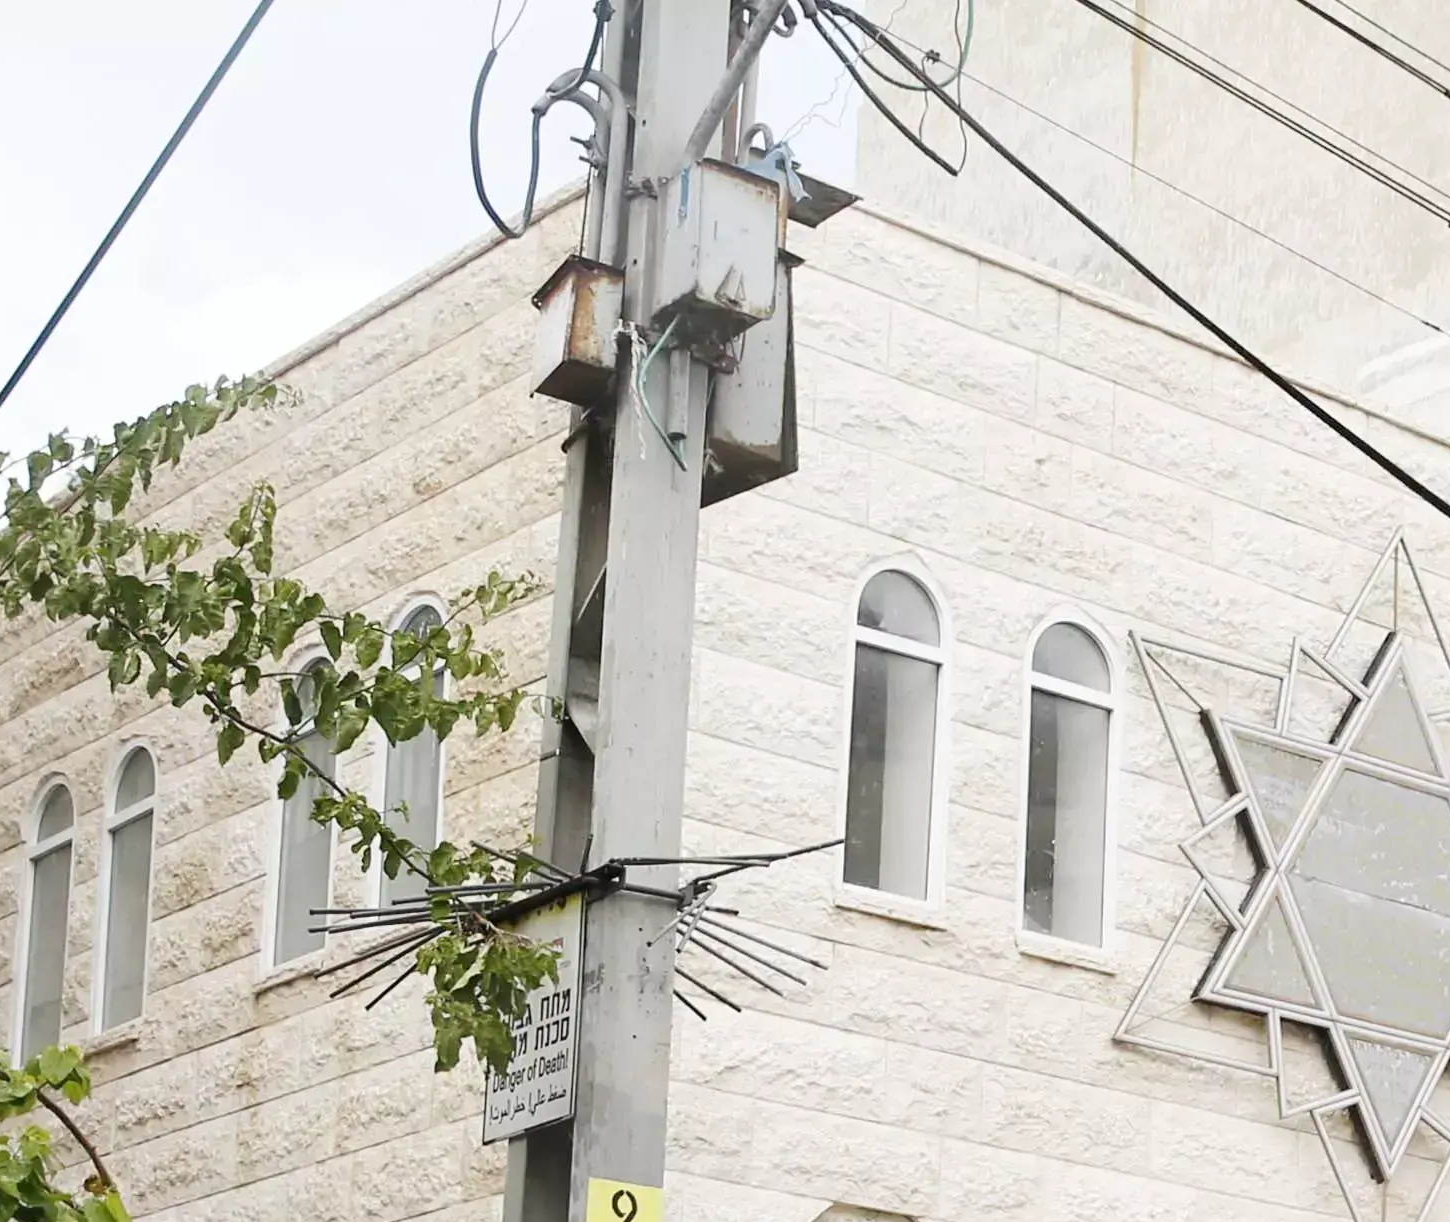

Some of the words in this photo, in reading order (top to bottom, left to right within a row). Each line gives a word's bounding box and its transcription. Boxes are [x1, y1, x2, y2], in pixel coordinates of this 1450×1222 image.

[540, 988, 571, 1021] מתח
[535, 1016, 570, 1050] סכנת
[493, 1070, 526, 1093] Danger
[527, 1058, 538, 1081] of
[539, 1048, 569, 1077] Death!
